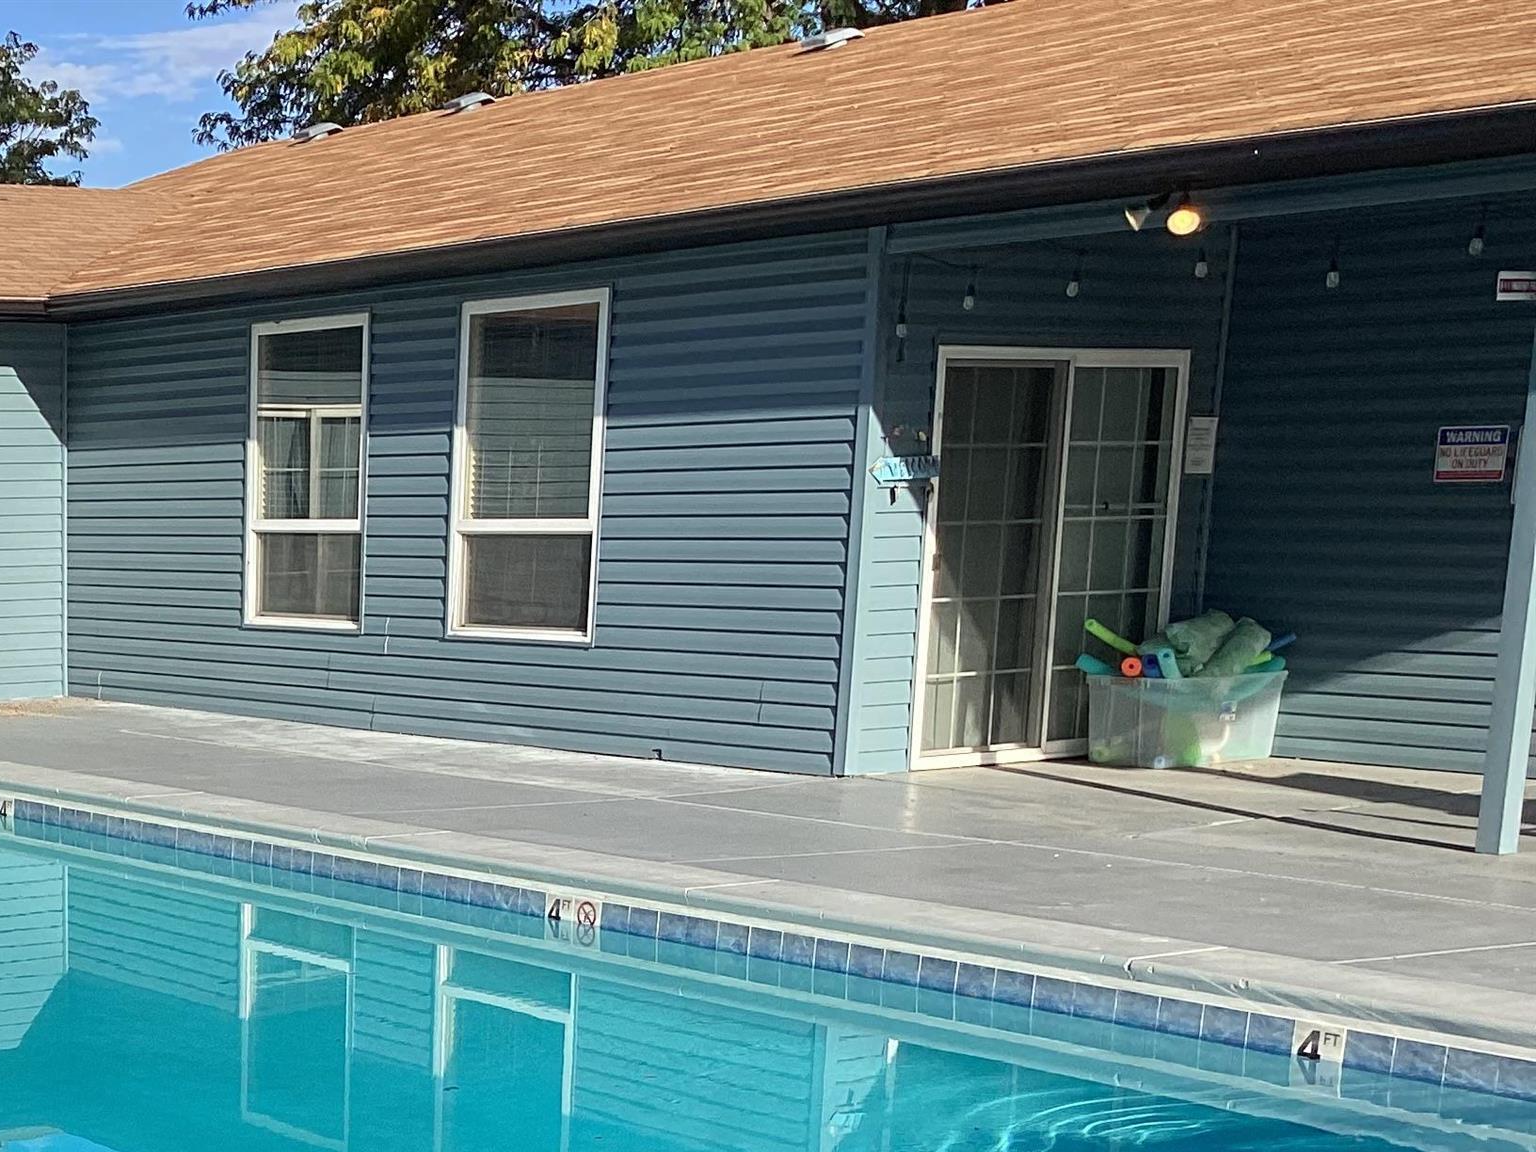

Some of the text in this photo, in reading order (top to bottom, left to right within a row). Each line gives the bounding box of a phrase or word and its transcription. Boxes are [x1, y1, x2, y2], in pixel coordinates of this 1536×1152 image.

[1446, 430, 1502, 443] WARNING
[1440, 446, 1503, 457] NO LIFEGUARD
[1451, 459, 1489, 468] ON DUTY
[0, 800, 7, 817] 4
[548, 898, 571, 921] 4 FT
[1297, 1029, 1341, 1060] 4 FT
